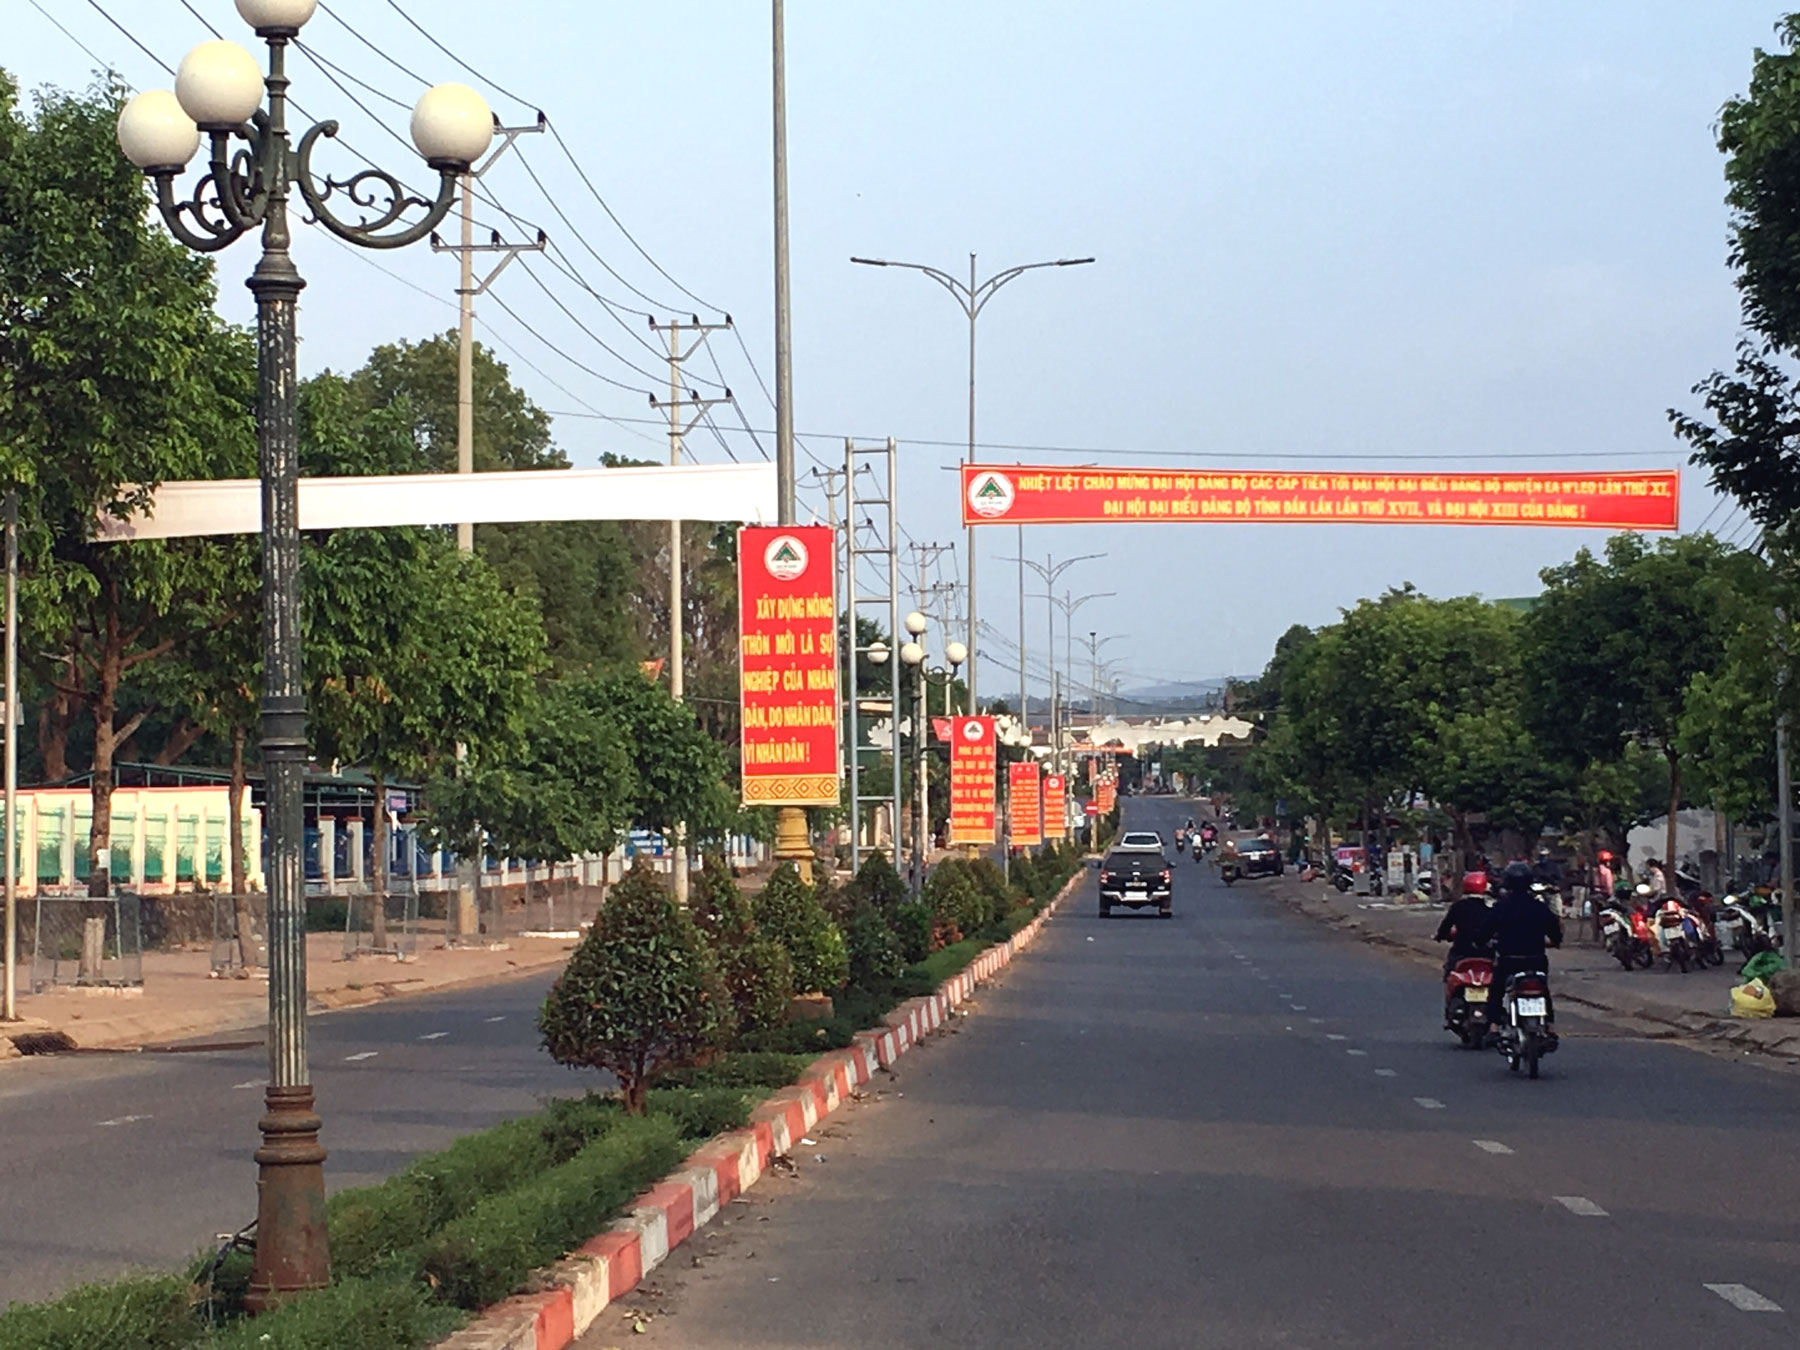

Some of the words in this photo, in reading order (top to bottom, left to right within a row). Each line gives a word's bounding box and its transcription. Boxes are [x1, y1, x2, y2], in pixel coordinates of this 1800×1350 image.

[1018, 473, 1051, 493] NHIỆT
[1055, 473, 1080, 493] LIỆT
[1083, 473, 1113, 490] CHÀO
[1117, 473, 1150, 490] MỪNG
[1152, 477, 1172, 492] ĐẠI
[1175, 474, 1194, 493] HỘI
[1231, 474, 1248, 492] BỘ
[1250, 474, 1273, 490] CÁC
[1276, 474, 1299, 490] CẤP
[1331, 475, 1350, 490] TỚI
[1375, 476, 1395, 493] HỘI
[1503, 477, 1543, 495] HUYỆN
[1545, 481, 1560, 493] EA
[1599, 478, 1622, 495] LẦN
[1624, 479, 1647, 496] THỨ
[1650, 482, 1671, 497] XI,
[1104, 500, 1122, 517] ĐẠI
[1127, 496, 1146, 517] HỘI
[1149, 500, 1168, 517] ĐẠI
[1235, 497, 1251, 517] BỘ
[1361, 498, 1385, 515] THỨ
[1387, 501, 1423, 516] XVII,
[1426, 499, 1442, 515] VÀ
[1445, 502, 1465, 517] ĐẠI
[1468, 499, 1488, 518] HỘI
[1491, 503, 1519, 517] XIII
[1520, 499, 1543, 517] CỦA
[1580, 505, 1586, 518] !
[756, 593, 775, 619] XÂY
[778, 596, 805, 623] DỰNG
[806, 592, 833, 618] NÔNG
[743, 630, 769, 655] THÔN
[776, 632, 795, 655] MỚI
[801, 629, 814, 654] LÀ
[820, 631, 833, 658] SỰ
[744, 670, 779, 695] NGHIỆP
[783, 662, 803, 691] CỦA
[807, 668, 835, 691] NHÂN
[744, 703, 767, 732] DÂN,
[769, 709, 783, 728] DO
[784, 700, 812, 727] NHÂN
[813, 700, 835, 731] DÂN,
[745, 740, 754, 764] VÌ
[755, 740, 783, 764] NHÂN
[785, 737, 804, 763] DÂN
